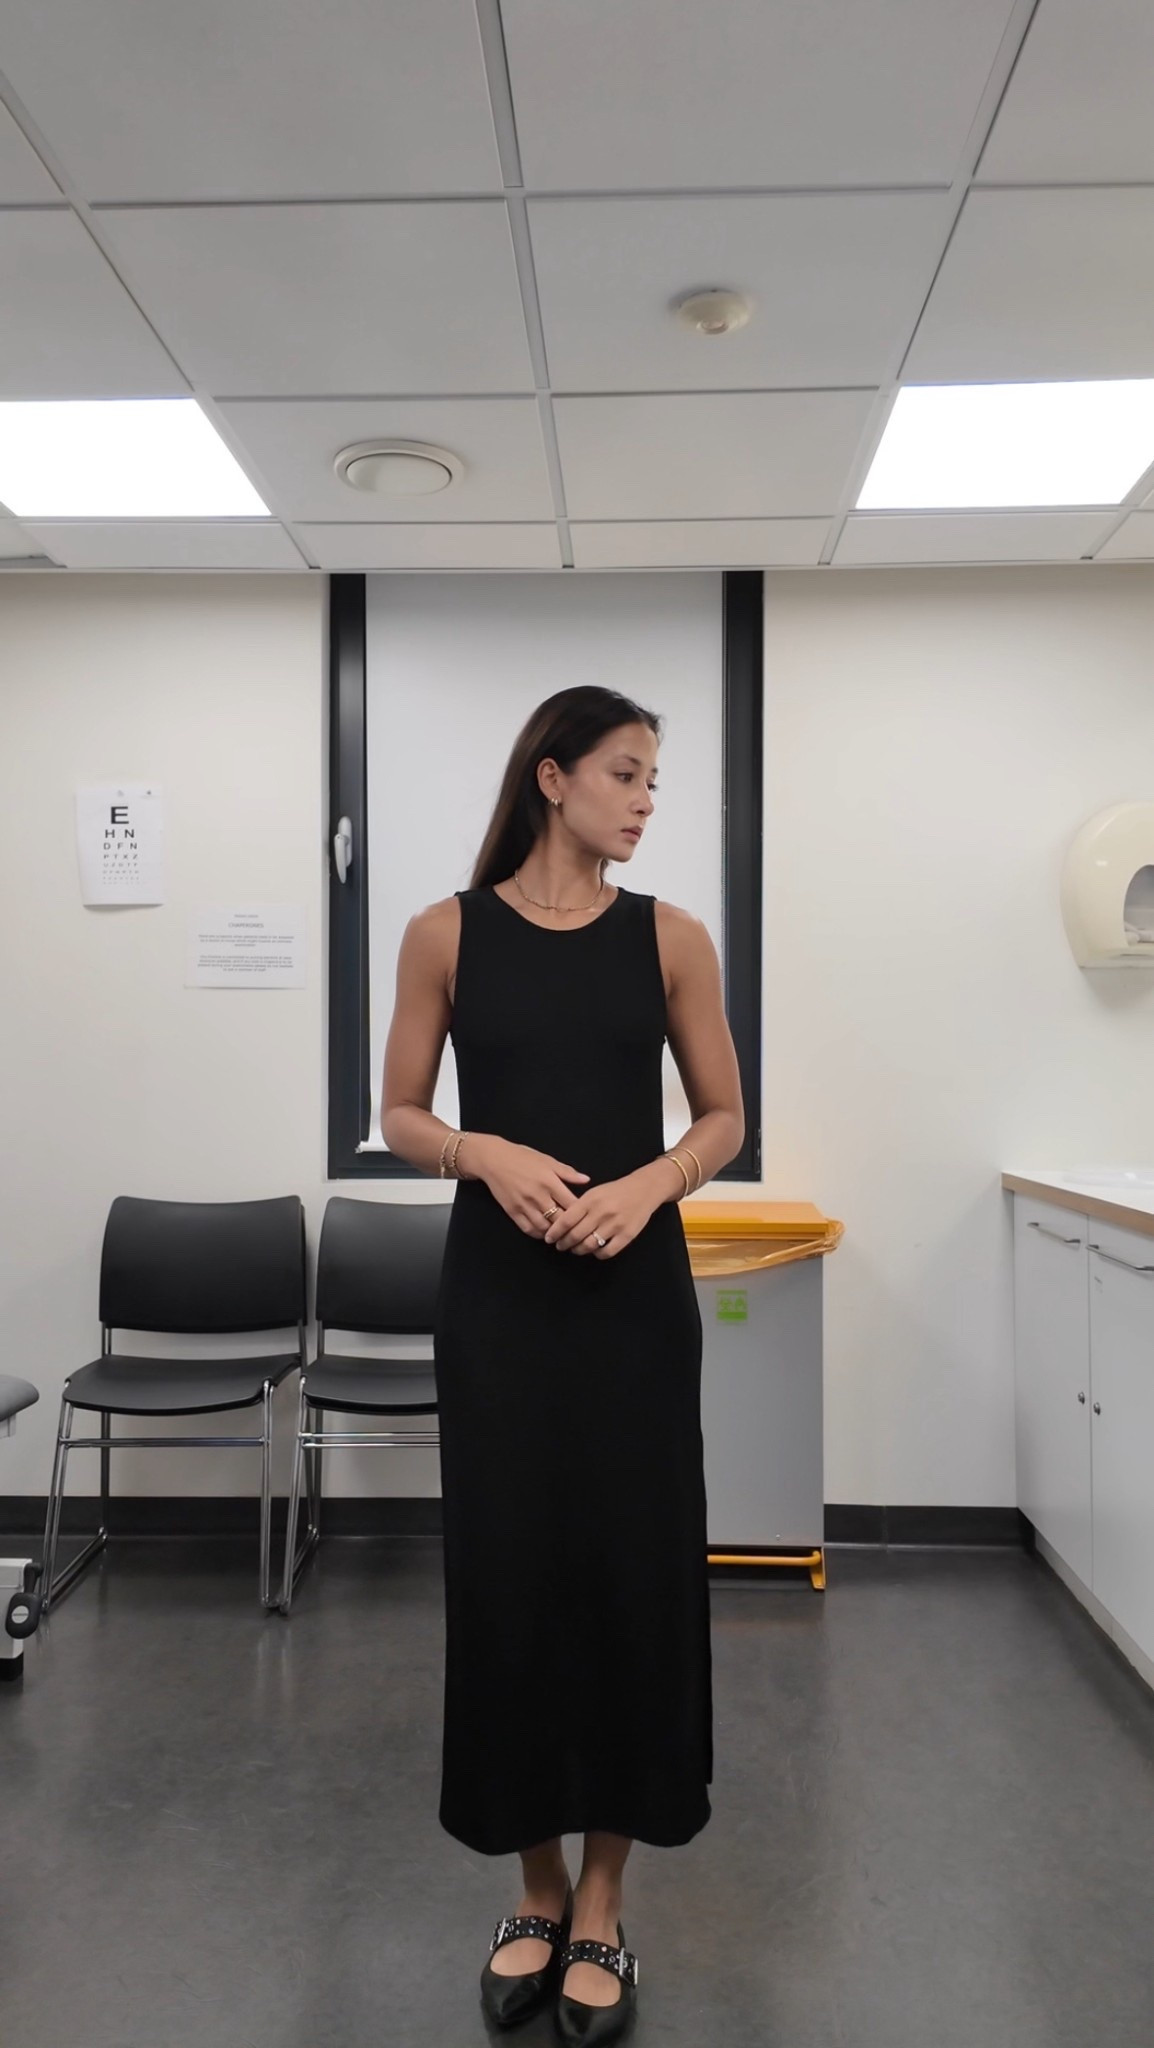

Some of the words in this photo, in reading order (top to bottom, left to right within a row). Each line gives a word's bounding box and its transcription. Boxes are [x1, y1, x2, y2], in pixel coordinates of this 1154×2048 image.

[111, 806, 129, 825] E
[105, 829, 115, 839] H
[125, 829, 135, 839] N
